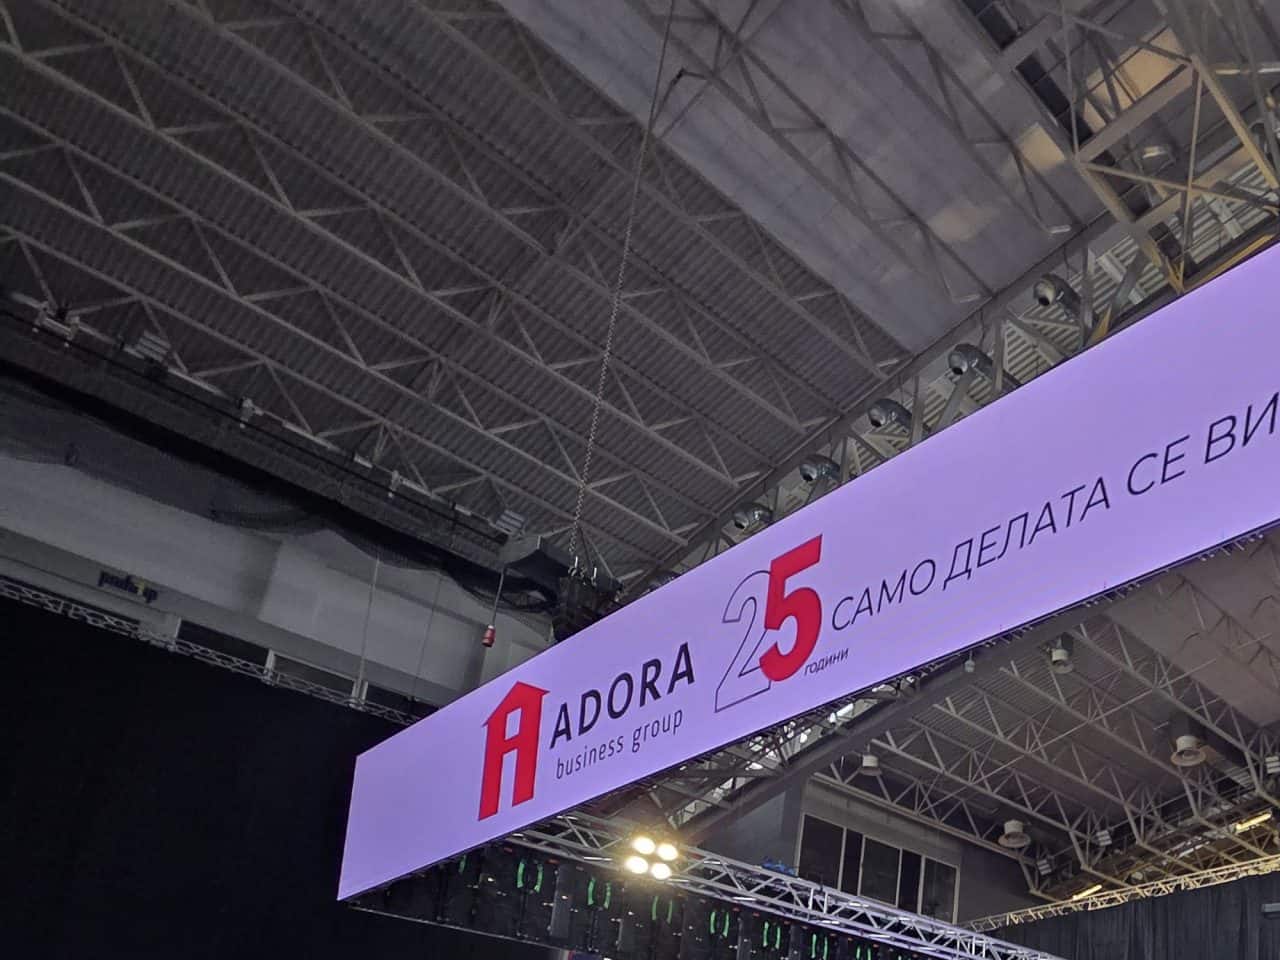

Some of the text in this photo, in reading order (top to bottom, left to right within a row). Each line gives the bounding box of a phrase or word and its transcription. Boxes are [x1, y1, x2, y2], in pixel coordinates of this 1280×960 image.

[832, 559, 936, 632] САМО
[942, 477, 1111, 591] ДЕЛАТА
[1127, 436, 1190, 496] СЕ
[715, 534, 823, 713] 25
[804, 648, 850, 677] години
[550, 642, 695, 749] ADORA
[556, 709, 684, 780] business group
